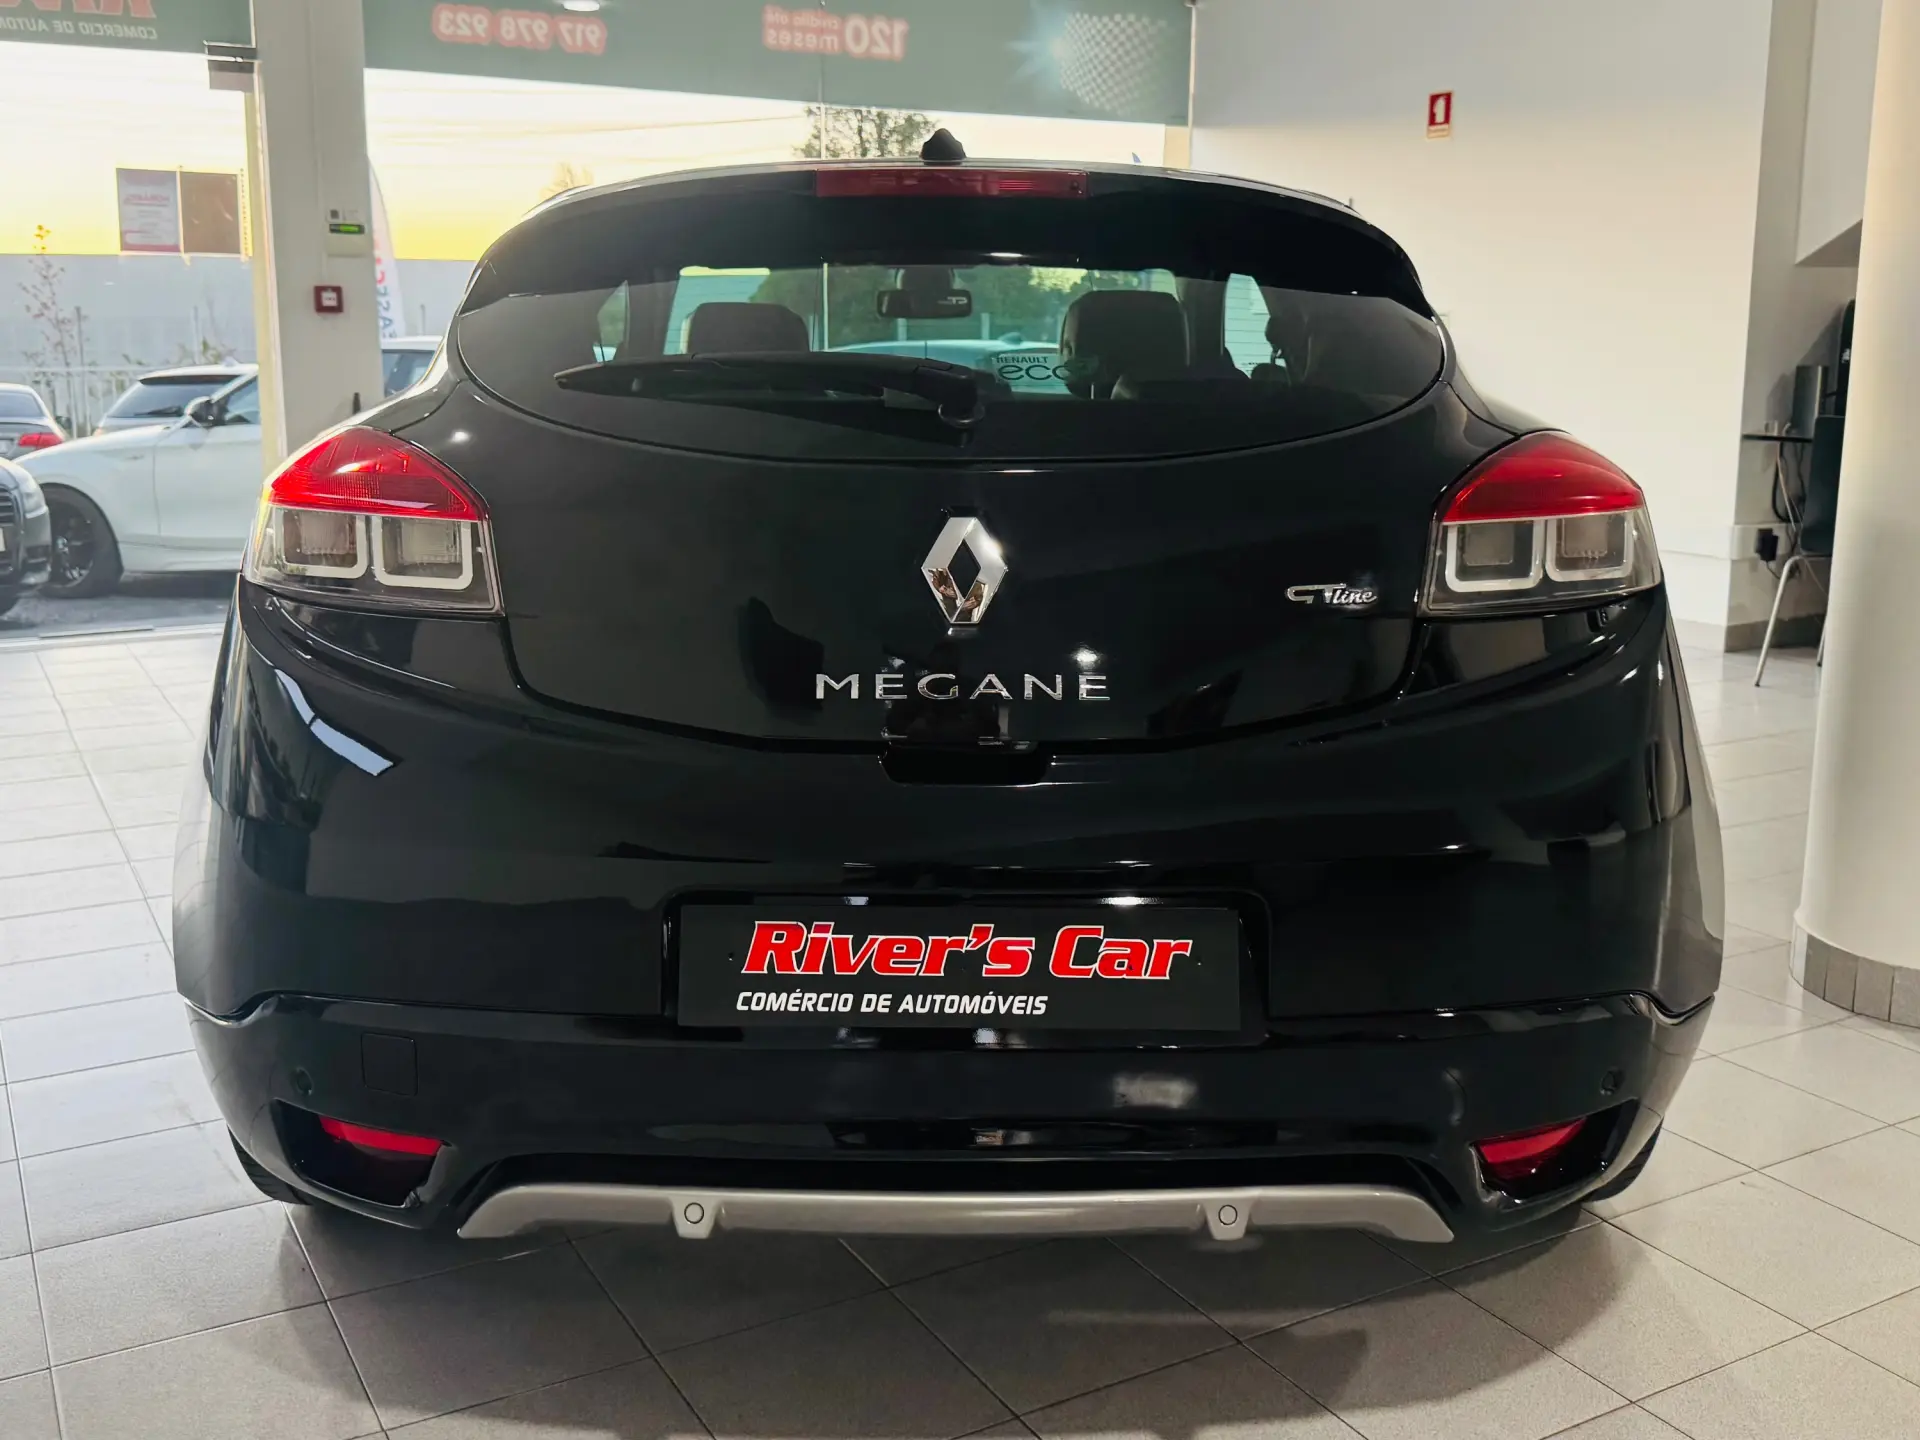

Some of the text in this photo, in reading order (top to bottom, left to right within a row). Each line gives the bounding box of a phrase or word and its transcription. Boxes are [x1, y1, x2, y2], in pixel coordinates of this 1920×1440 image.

[996, 356, 1049, 364] RENAULT
[816, 673, 1110, 700] MEGANE
[741, 921, 1193, 979] River's Car
[736, 989, 1048, 1015] COMÉRCIO DE AUTOMÓVEIS
